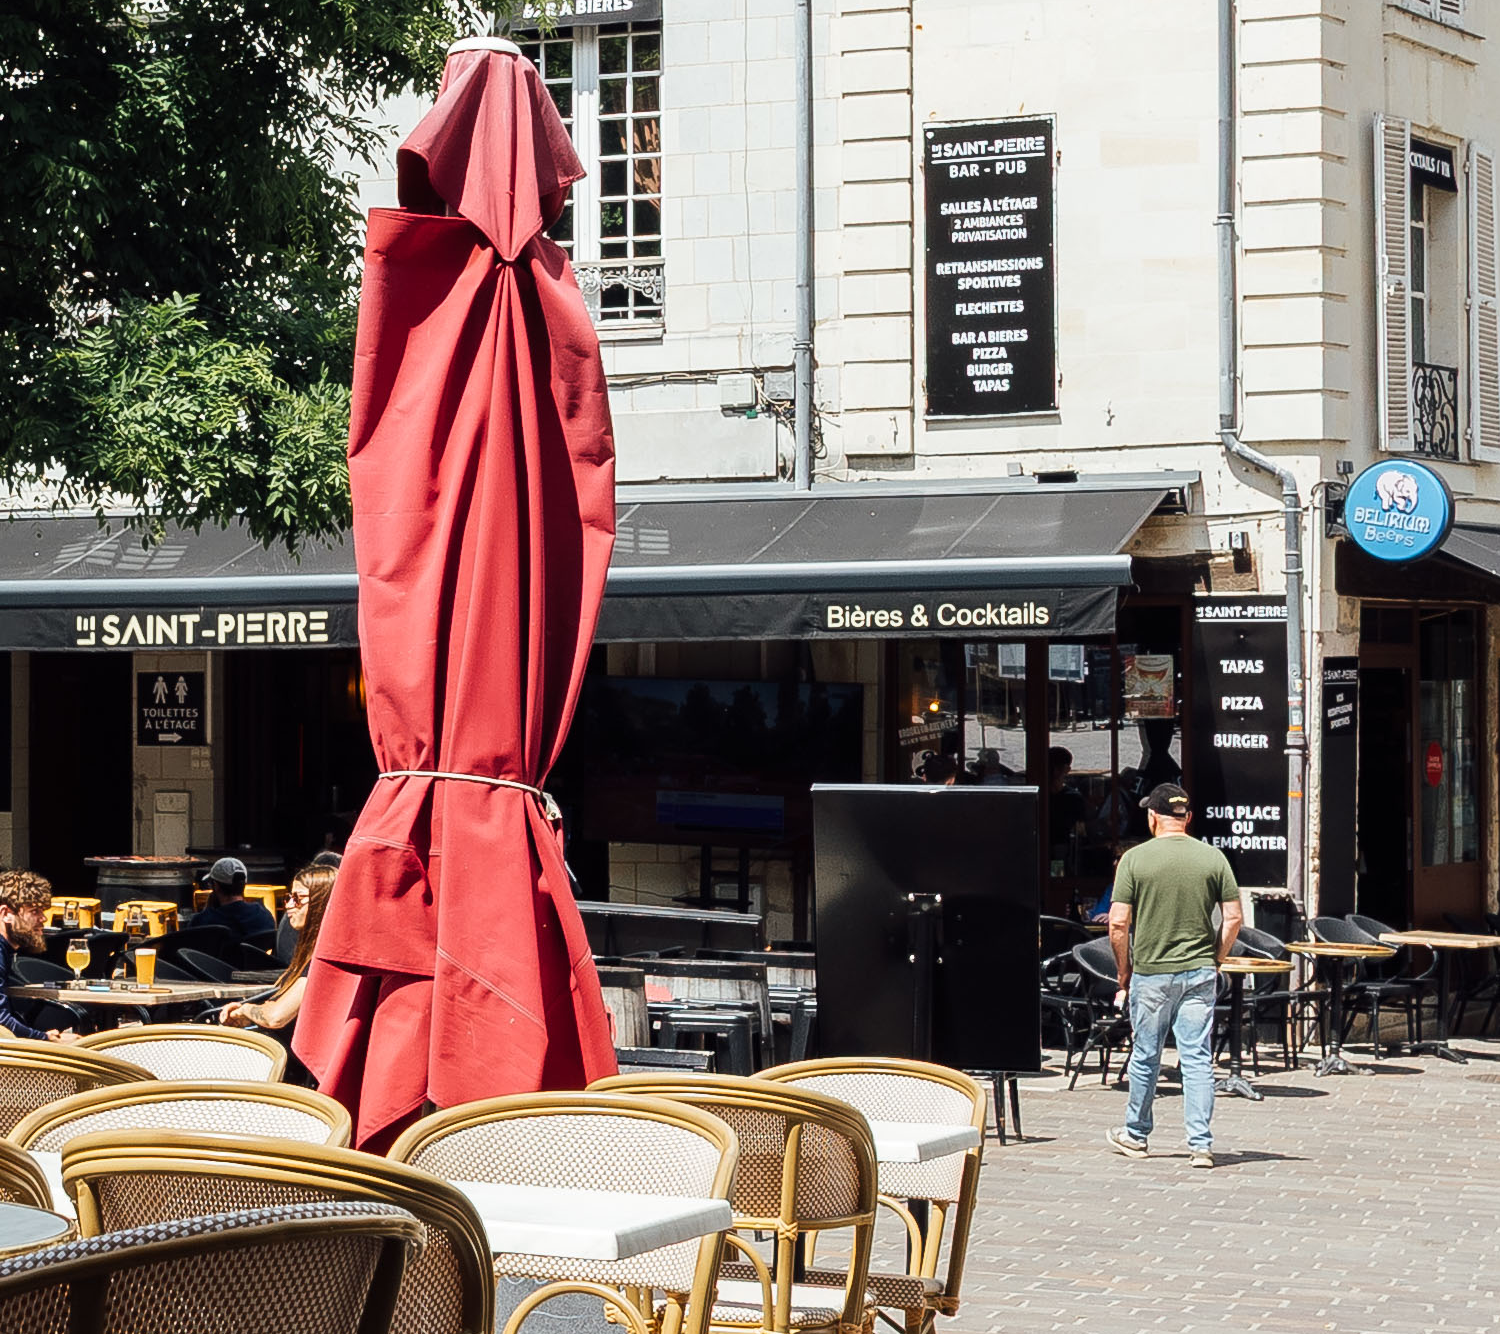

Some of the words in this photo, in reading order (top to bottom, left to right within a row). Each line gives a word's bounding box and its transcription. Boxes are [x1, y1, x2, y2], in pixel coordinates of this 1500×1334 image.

[943, 136, 1046, 157] SAINT-PIERRE
[949, 164, 980, 179] BAR
[995, 160, 1027, 175] PUB
[940, 200, 982, 215] SALLES
[954, 218, 962, 230] 2
[962, 215, 1024, 229] AMBIANCES
[951, 228, 1028, 243] PRIVATISATION
[936, 257, 1044, 275] RETRANSMISSIONS
[957, 275, 1021, 290] SPORTIVES
[955, 300, 1025, 316] FLECHETTES
[952, 332, 976, 345] BAR
[987, 329, 1028, 344] BIERES
[972, 347, 1008, 360] PIZZA
[967, 363, 1014, 377] BURGER
[973, 379, 1010, 393] TAPAS
[1354, 507, 1431, 534] DELIRIUM
[1364, 526, 1415, 547] Beers
[827, 605, 904, 628] Bières
[910, 604, 929, 627] &
[937, 602, 1050, 627] Cocktails
[1204, 605, 1289, 618] SAINT-PIERRE
[101, 611, 329, 646] SAINT-PIERRE
[1220, 660, 1264, 674] TAPAS
[1221, 696, 1264, 711] PIZZA
[143, 707, 199, 718] TOILETTES
[145, 718, 152, 729] À
[155, 718, 197, 730] L'ÉTAGE
[1214, 734, 1269, 749] BURGER
[1206, 806, 1234, 820] SUR
[1236, 806, 1281, 820] PLACE
[1232, 821, 1254, 835] OU
[1212, 836, 1287, 851] EMPORTER
